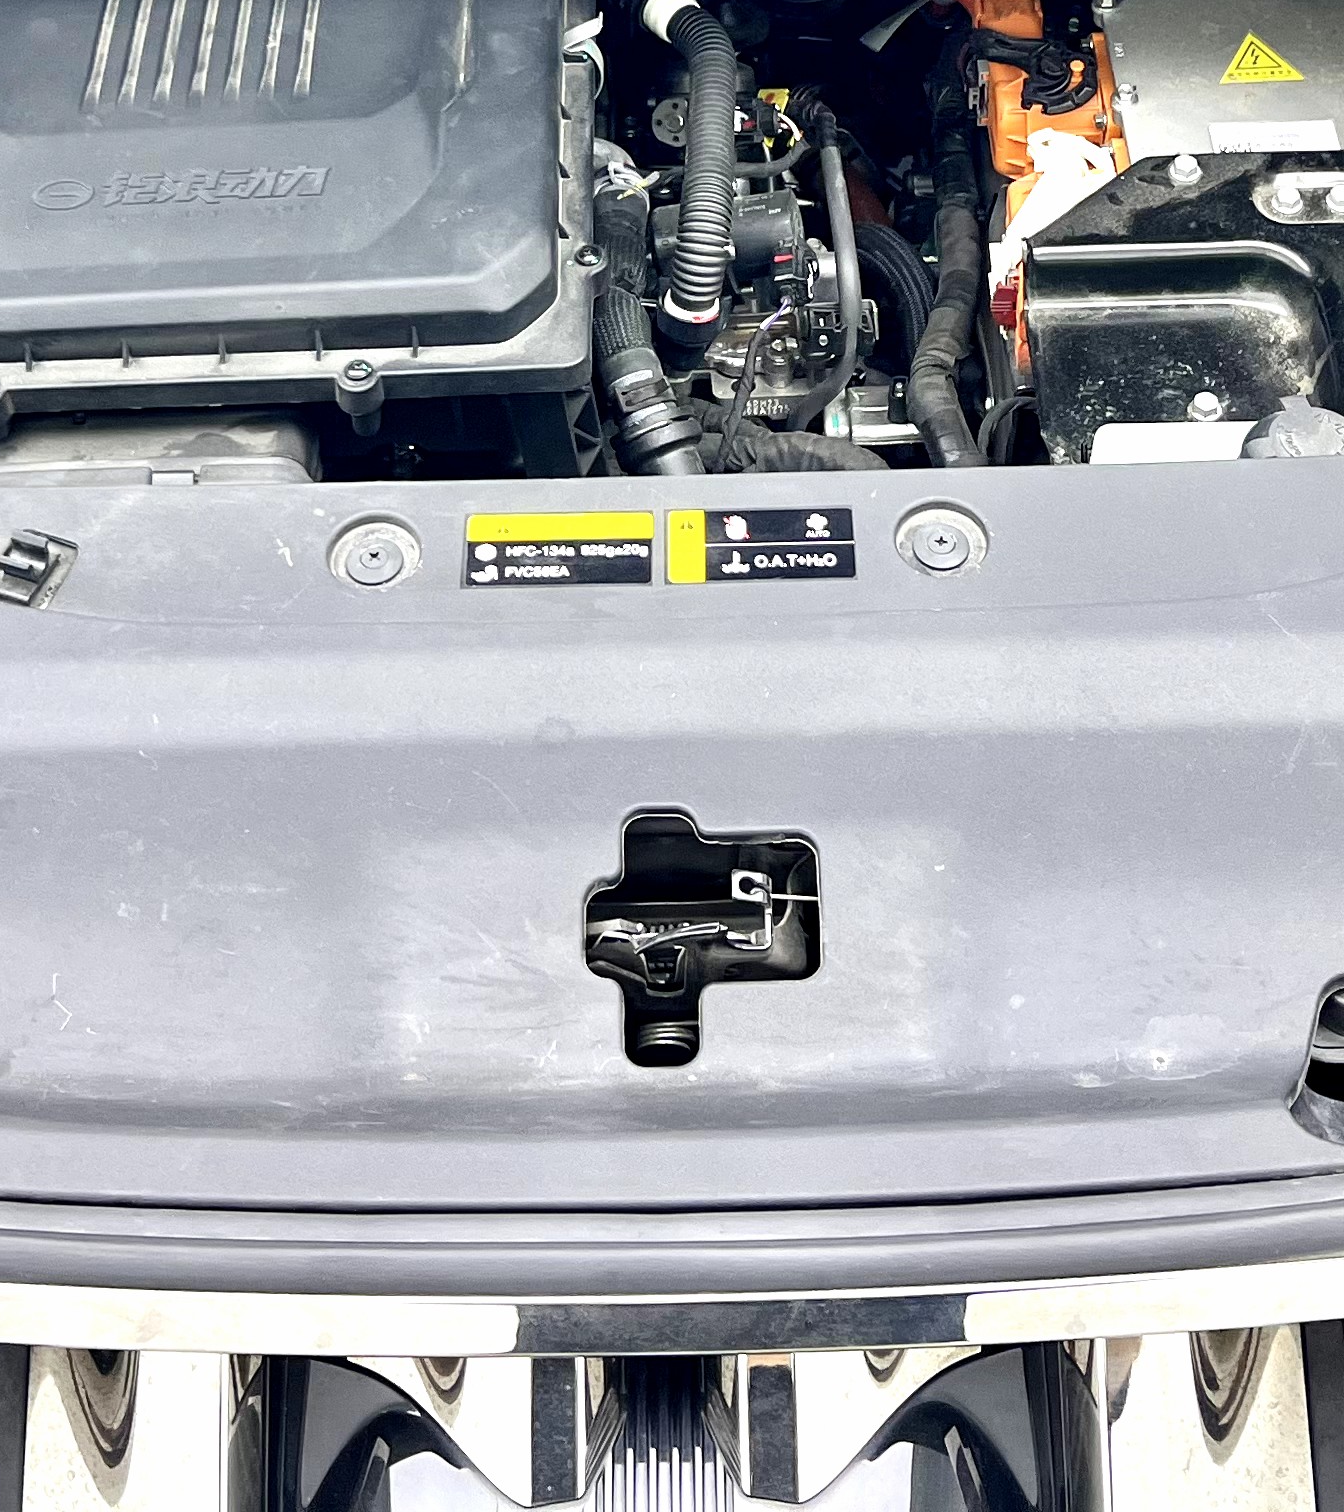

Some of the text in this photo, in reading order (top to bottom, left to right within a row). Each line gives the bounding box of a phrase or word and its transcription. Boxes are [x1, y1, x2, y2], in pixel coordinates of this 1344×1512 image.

[104, 166, 331, 206] 钜浪动力
[506, 544, 575, 558] HFC-134a
